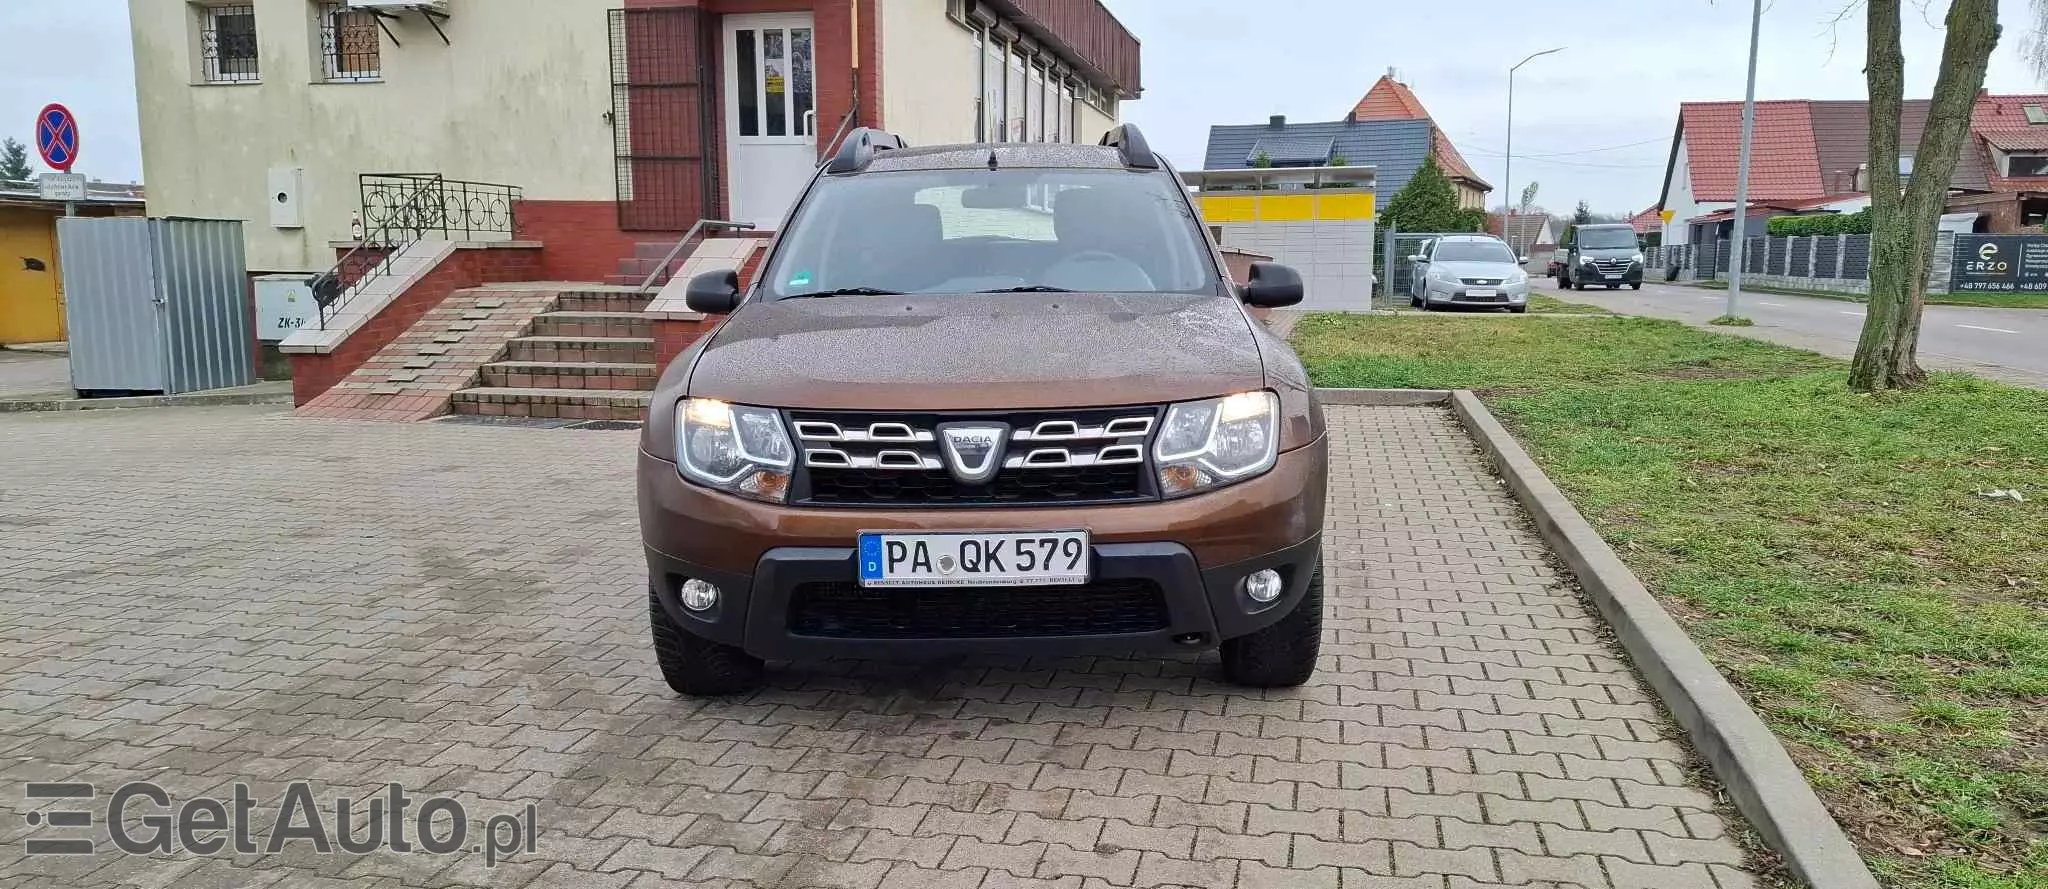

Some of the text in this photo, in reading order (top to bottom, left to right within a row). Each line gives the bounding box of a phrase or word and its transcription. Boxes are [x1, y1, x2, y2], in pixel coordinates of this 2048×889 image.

[1966, 261, 2007, 271] ERZO
[886, 537, 1082, 573] PA QK 579
[868, 562, 876, 571] D
